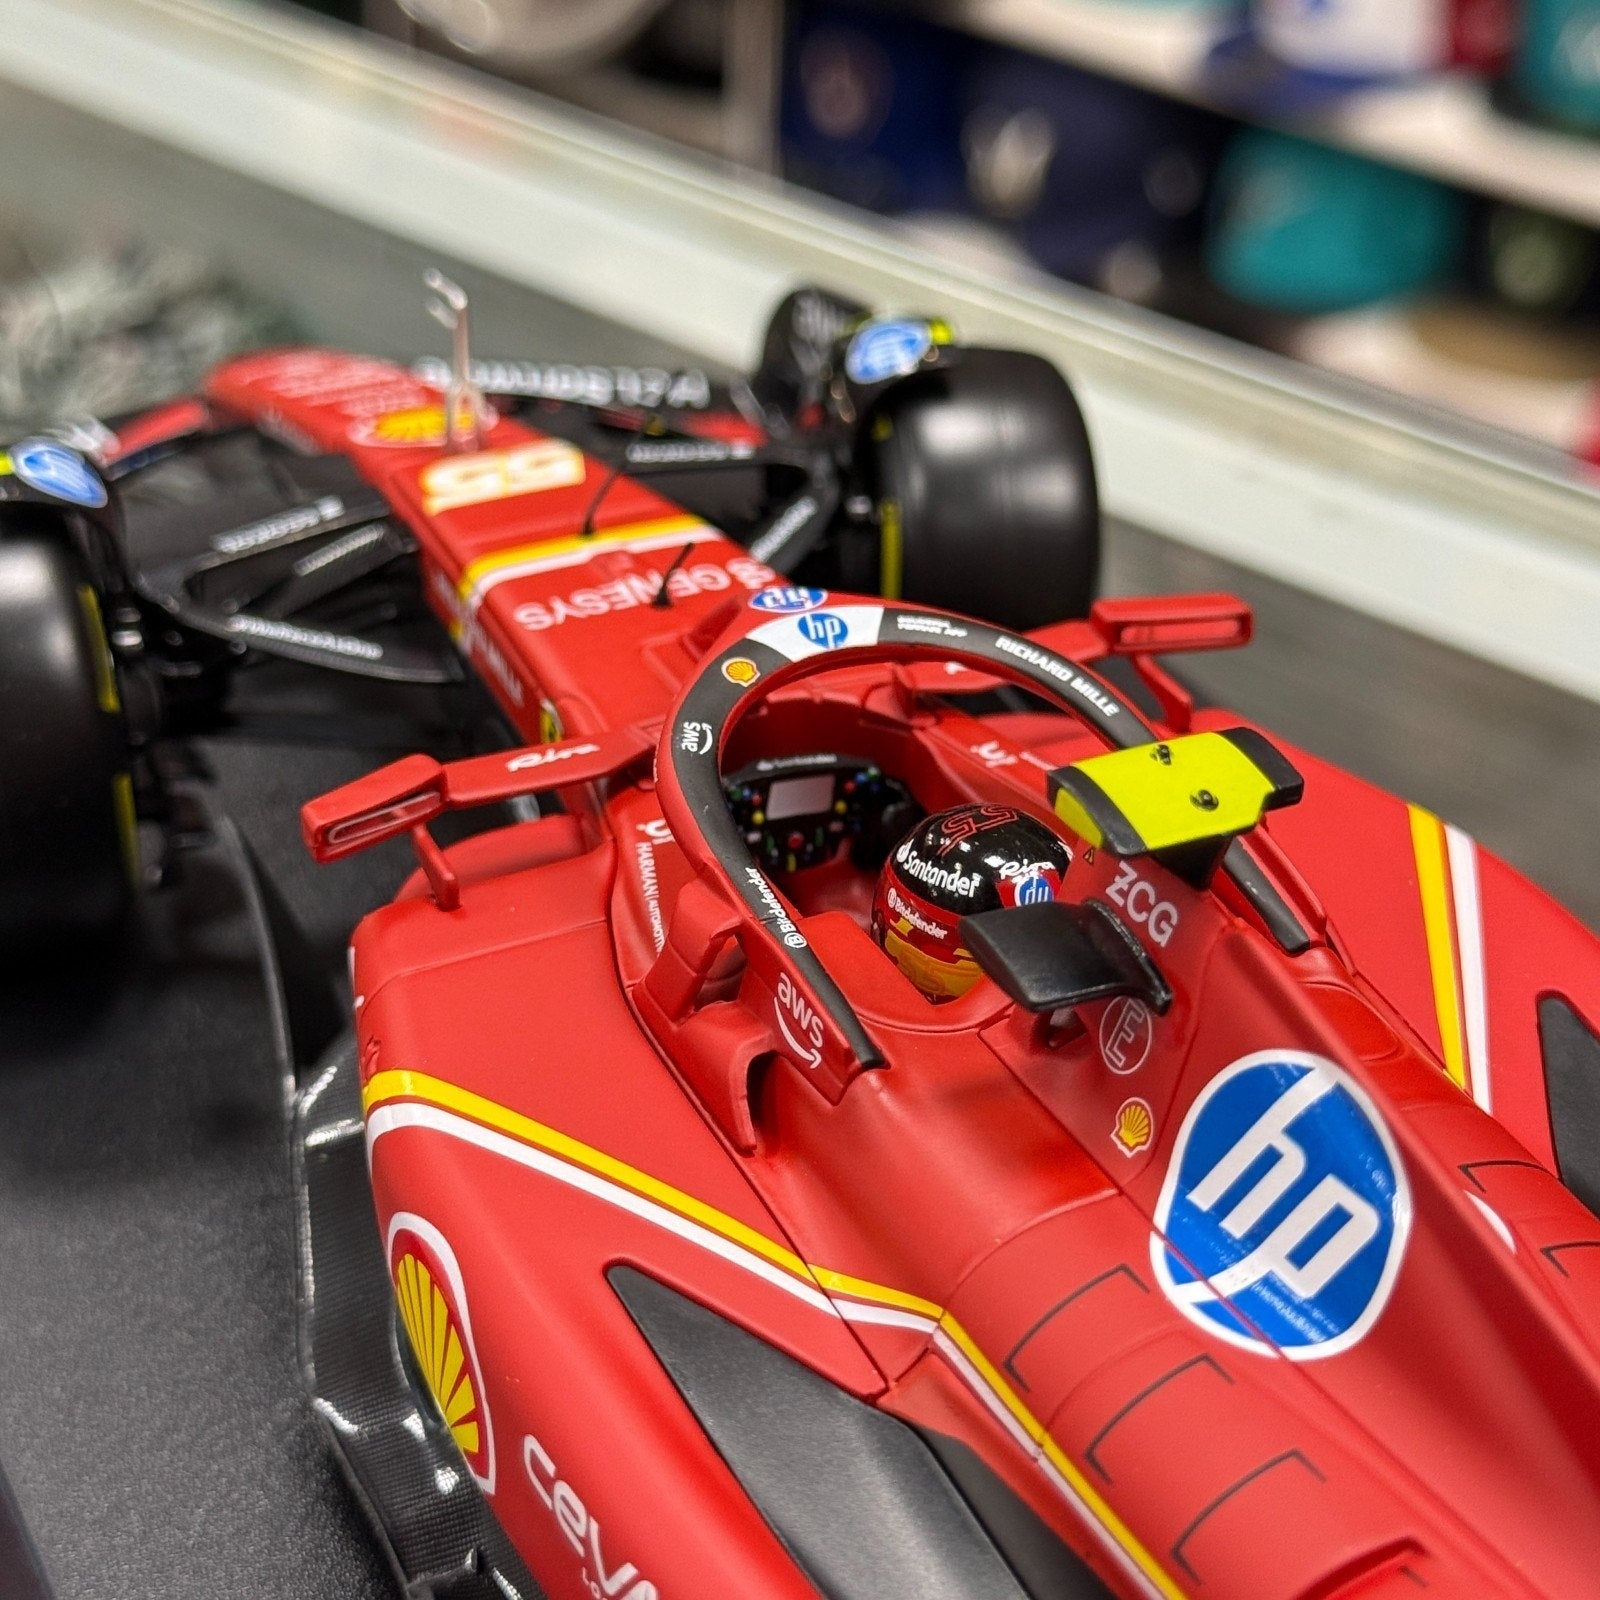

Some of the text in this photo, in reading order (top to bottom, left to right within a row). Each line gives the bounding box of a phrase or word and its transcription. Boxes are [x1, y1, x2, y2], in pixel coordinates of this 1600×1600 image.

[513, 562, 732, 631] GENESYS
[805, 612, 841, 650] hp
[995, 635, 1120, 717] RICHARD MILLE
[681, 721, 703, 752] aws
[635, 842, 659, 900] HARMAN
[745, 867, 797, 933] Bitdefender
[903, 850, 979, 898] Santander
[895, 896, 948, 940] Bitdefender
[1106, 862, 1179, 947] ZCG
[777, 972, 824, 1048] aws
[1165, 1060, 1385, 1305] hp
